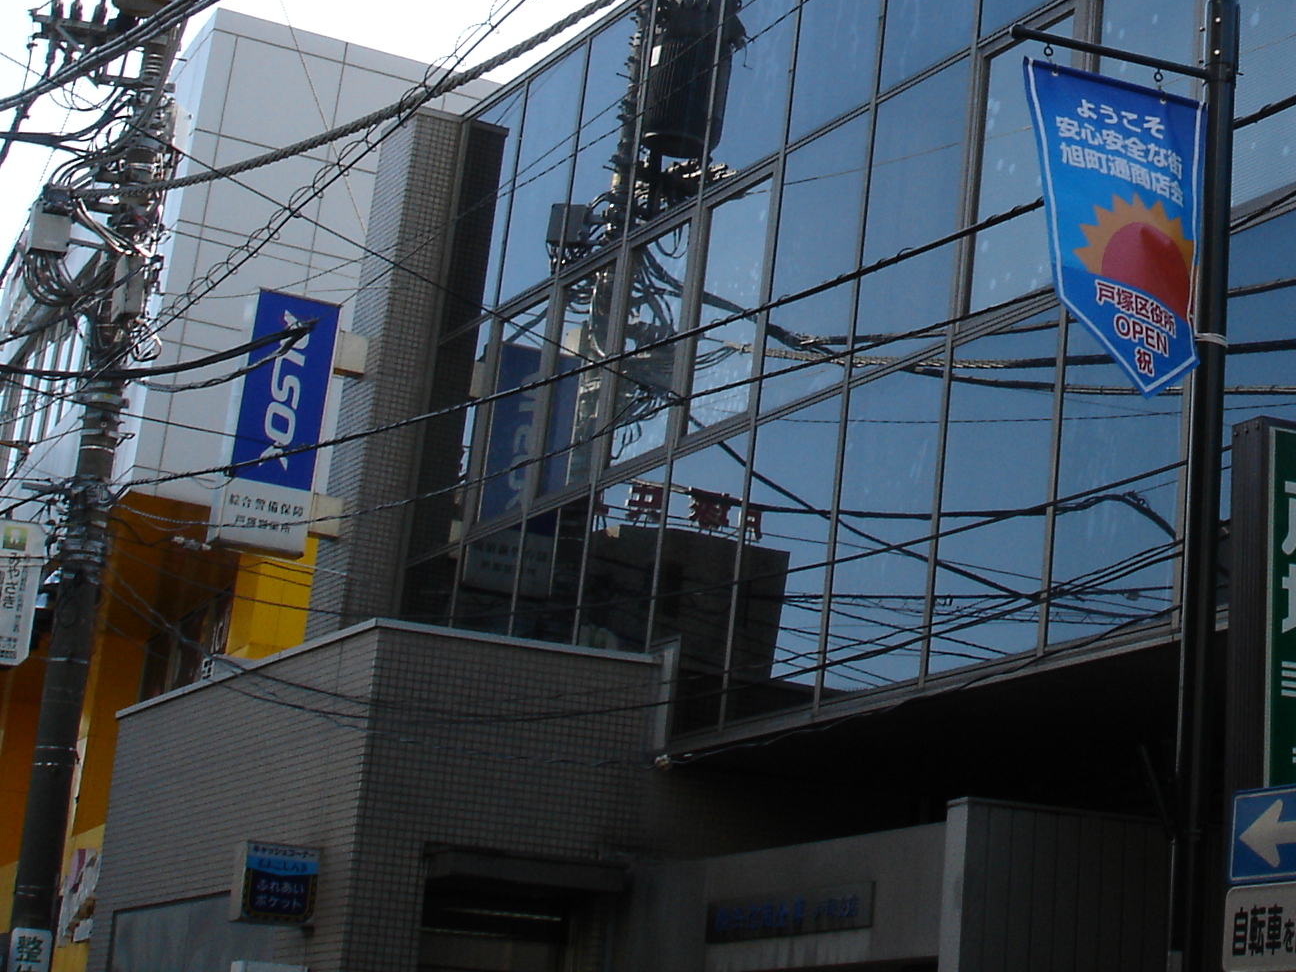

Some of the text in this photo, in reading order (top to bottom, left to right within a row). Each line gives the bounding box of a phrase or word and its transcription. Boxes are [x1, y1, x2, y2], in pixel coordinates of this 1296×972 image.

[1077, 99, 1165, 140] ようこそ
[1055, 116, 1182, 180] 安心安全な街
[1060, 140, 1184, 208] 旭町通商店会
[1096, 281, 1176, 337] 戸塚区役所
[1115, 314, 1168, 357] OPEN
[1136, 348, 1154, 377] 祝
[258, 309, 310, 471] ALSOK
[15, 935, 43, 972] 整
